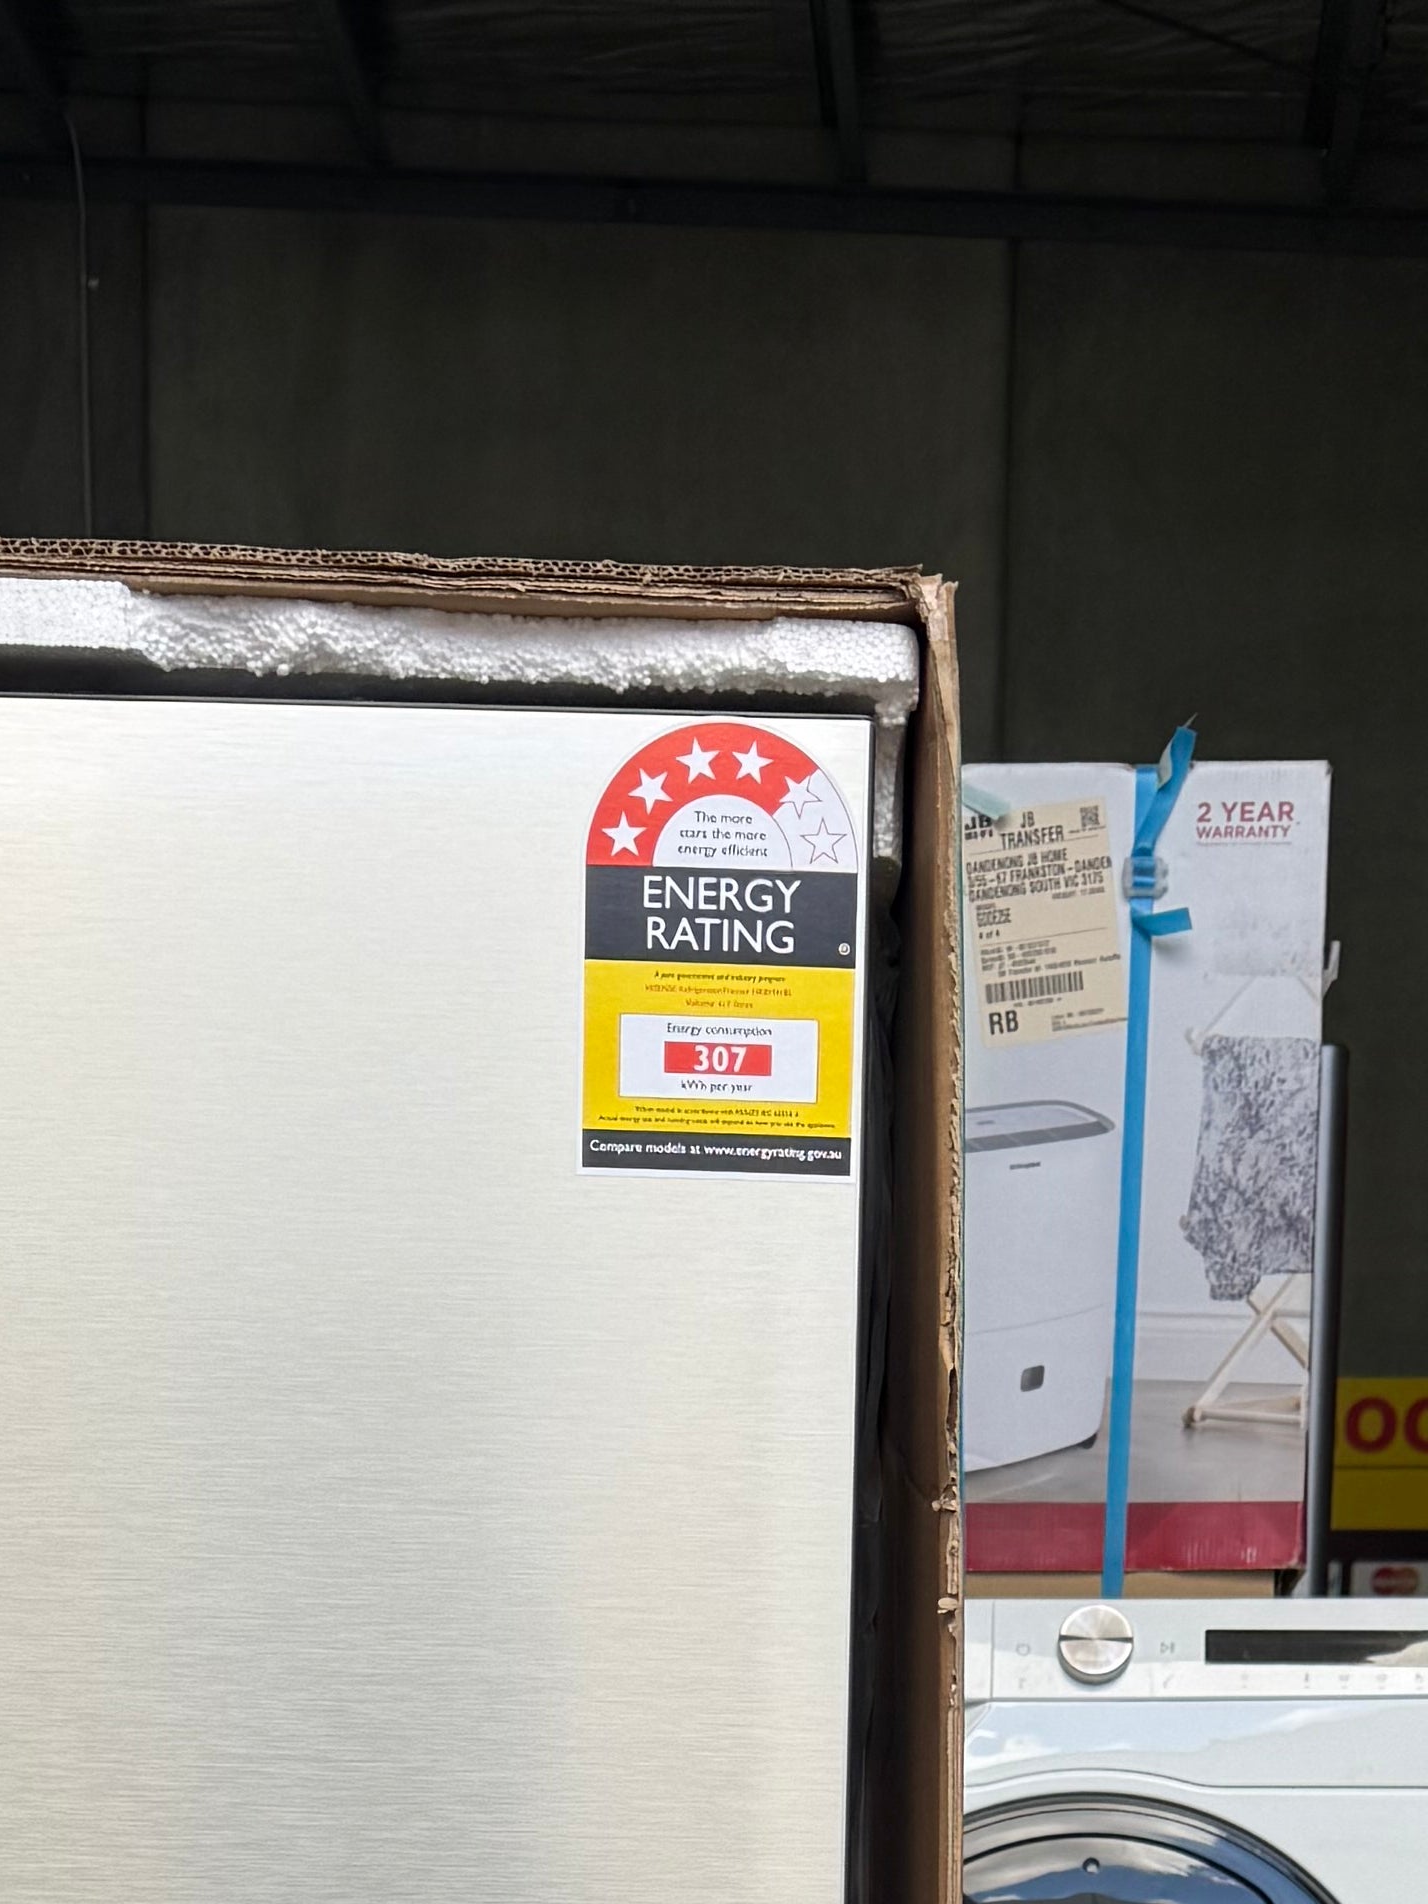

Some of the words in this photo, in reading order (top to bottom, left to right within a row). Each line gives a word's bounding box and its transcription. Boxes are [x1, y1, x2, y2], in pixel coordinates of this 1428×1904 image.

[694, 811, 717, 823] The
[722, 815, 752, 824] more
[1021, 812, 1035, 828] JB
[1198, 803, 1213, 822] 2
[1221, 801, 1294, 822] YEAR
[713, 830, 730, 839] the
[735, 831, 766, 841] more
[1000, 825, 1064, 850] TRANSFER
[1196, 825, 1291, 841] WARRANTY
[678, 846, 717, 857] energy
[722, 844, 767, 857] efficient
[1041, 849, 1067, 863] HOME
[1010, 863, 1065, 883] FRANKSTON
[643, 875, 801, 913] ENERGY
[1029, 877, 1061, 894] SOUTH
[647, 917, 794, 954] RATING
[667, 1023, 702, 1036] Energy
[706, 1027, 772, 1037] consumption
[989, 1010, 1019, 1035] RB
[694, 1045, 747, 1072] 307
[681, 1080, 707, 1090] kWh
[710, 1083, 727, 1092] per
[590, 1140, 642, 1154] Compare
[646, 1142, 685, 1154] models
[690, 1146, 700, 1155] at
[704, 1145, 842, 1161] www.energyrating.gov.au
